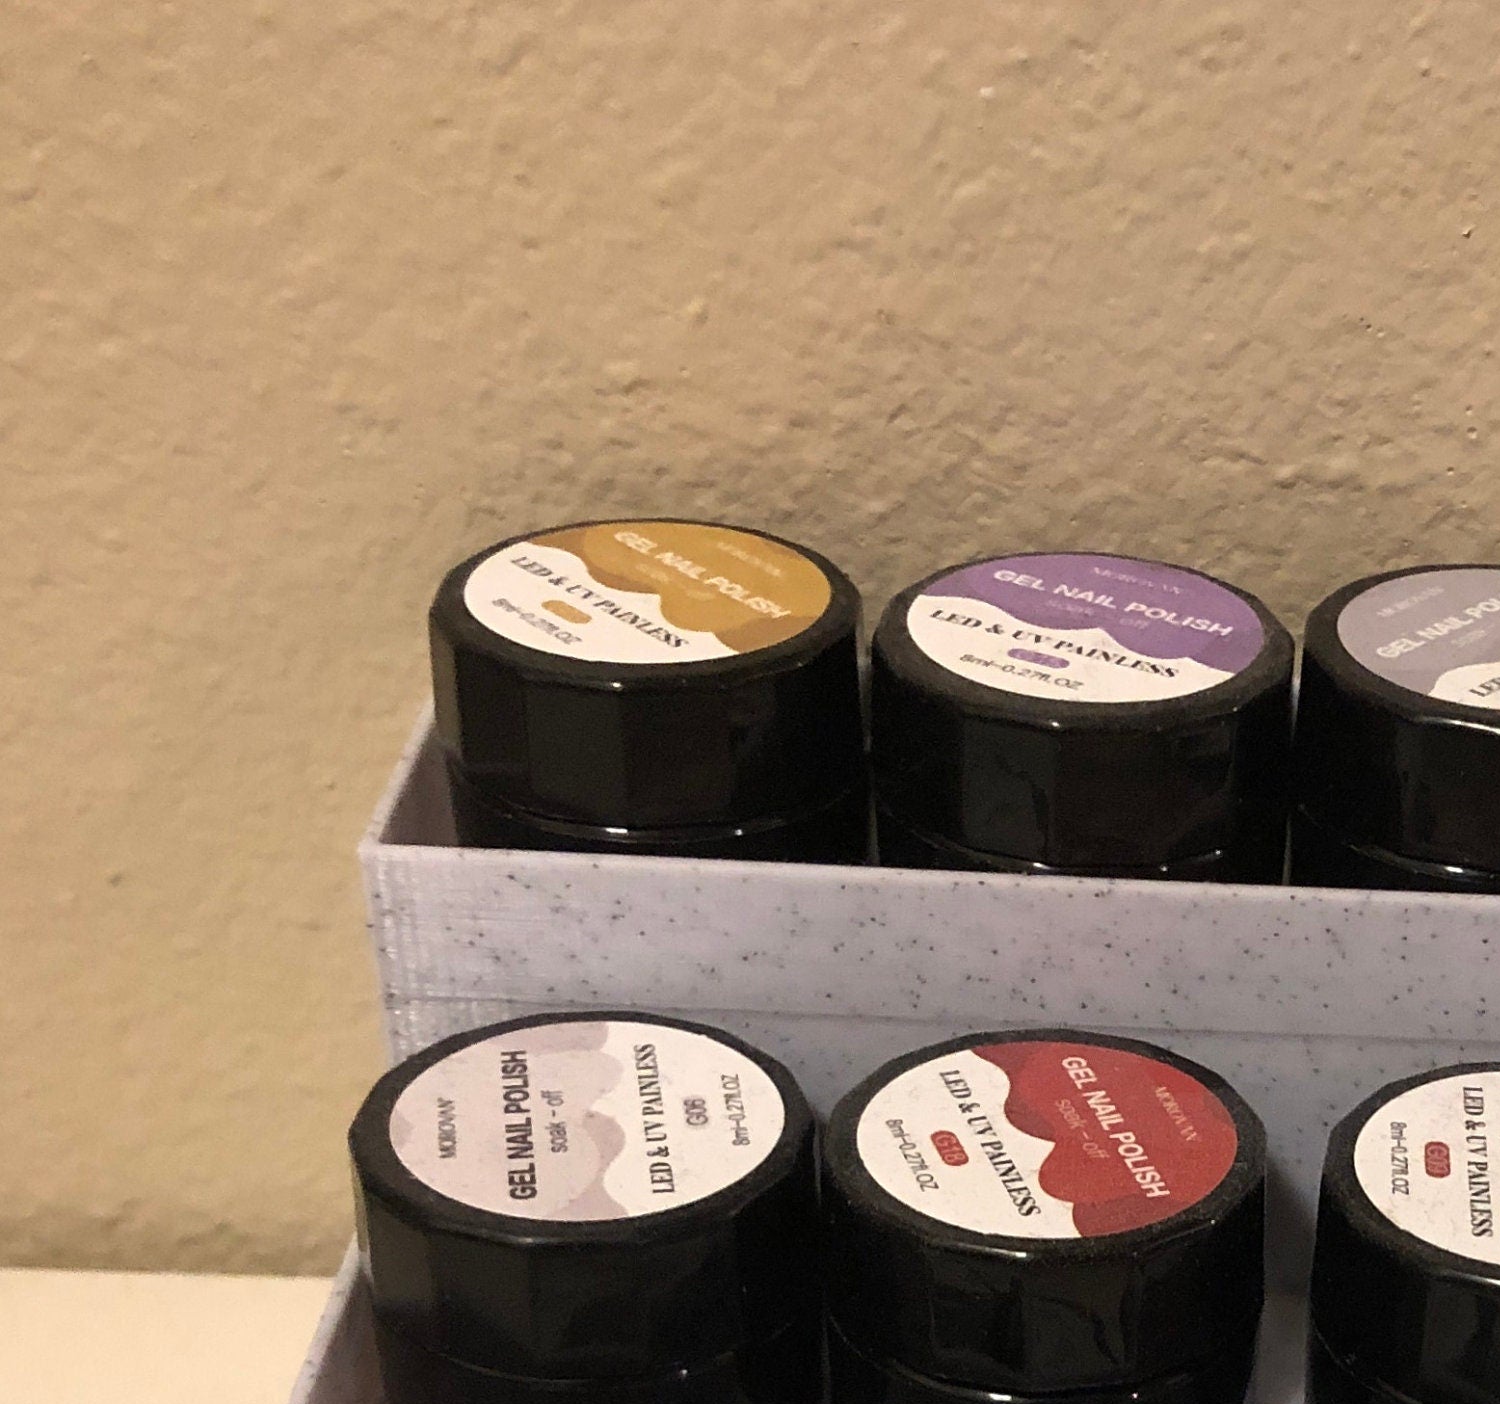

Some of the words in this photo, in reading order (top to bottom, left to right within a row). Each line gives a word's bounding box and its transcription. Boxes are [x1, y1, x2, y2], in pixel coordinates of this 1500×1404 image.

[988, 569, 1055, 591] GEL
[1049, 584, 1126, 609] NAIL
[1121, 601, 1237, 636] POLISH
[926, 608, 986, 629] LED
[982, 623, 1011, 635] &
[1008, 629, 1057, 647] UV
[1050, 640, 1182, 679] PAINLESS
[1371, 634, 1429, 659] GEL
[1413, 612, 1476, 640] NAIL
[498, 1049, 532, 1114] POLISH
[633, 1043, 665, 1116] PAINLESS
[938, 1069, 974, 1100] LED
[1057, 1055, 1102, 1089] GEL
[540, 1089, 564, 1106] off
[956, 1100, 983, 1114] &
[1079, 1089, 1129, 1131] NAIL
[1461, 1085, 1484, 1117] LED
[433, 1097, 458, 1159] MOROVAN
[503, 1116, 535, 1160] NAIL
[544, 1120, 570, 1153] soak
[642, 1116, 668, 1142] UV
[964, 1115, 998, 1141] UV
[1050, 1097, 1089, 1130] soak
[1079, 1141, 1110, 1160] off
[1464, 1118, 1485, 1131] &
[646, 1144, 670, 1158] &
[1106, 1130, 1174, 1198] POLISH
[1465, 1134, 1487, 1159] UV
[507, 1162, 539, 1200] GEL
[648, 1160, 675, 1194] LED
[978, 1139, 1043, 1217] PAINLESS
[1466, 1160, 1493, 1238] PAINLESS
